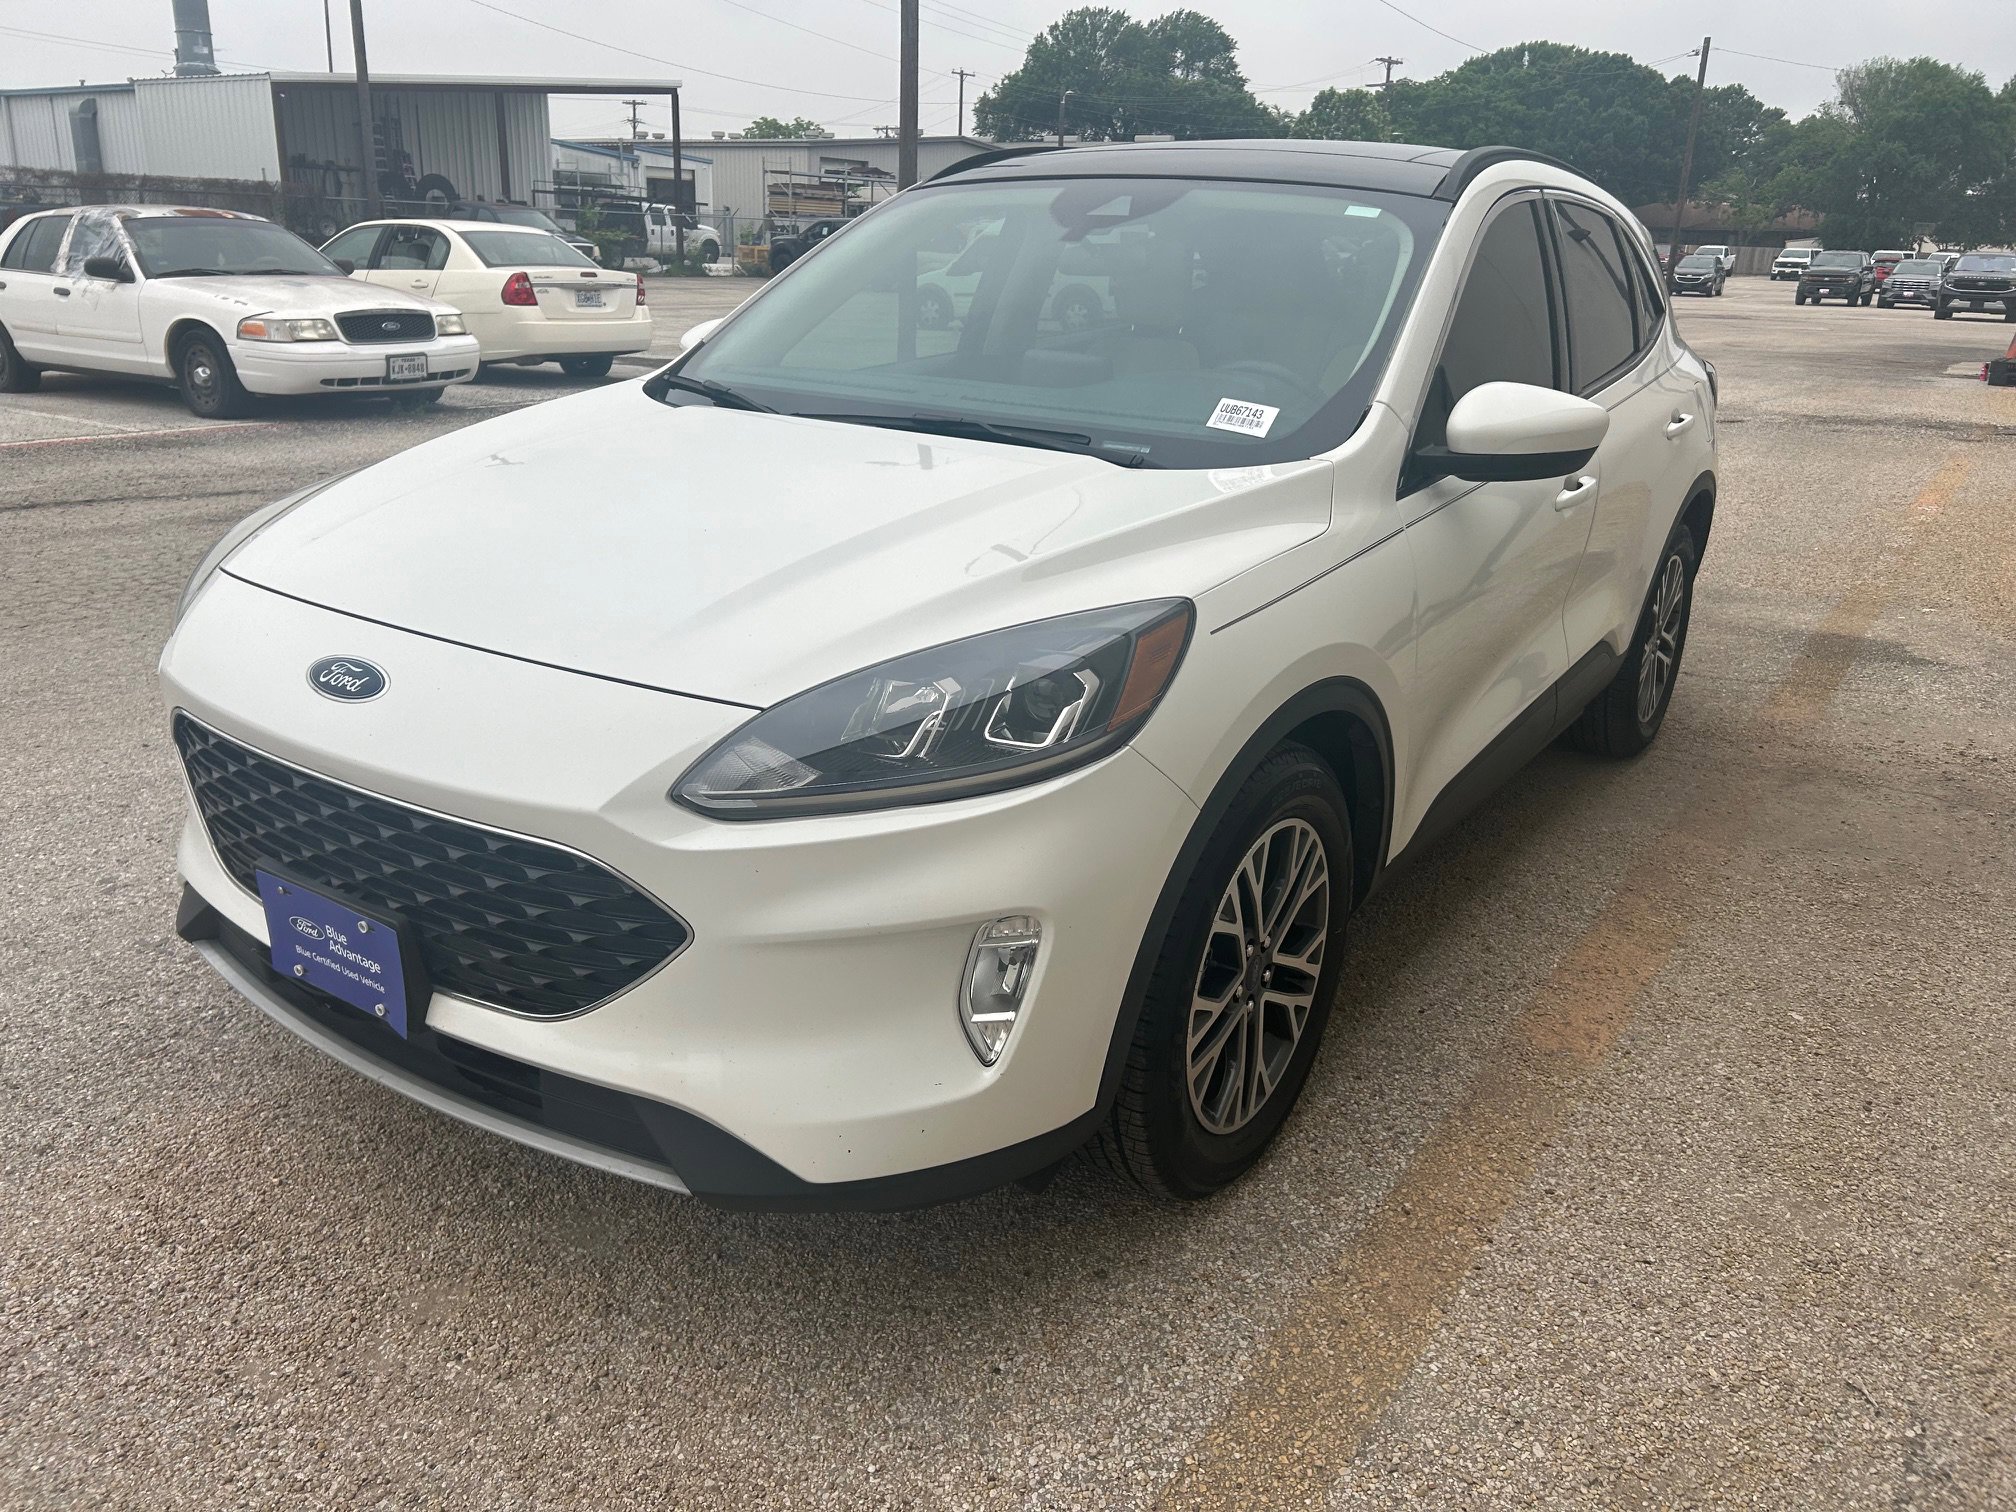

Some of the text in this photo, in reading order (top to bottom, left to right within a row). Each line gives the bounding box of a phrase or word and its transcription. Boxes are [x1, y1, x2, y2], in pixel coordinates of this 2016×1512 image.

[1220, 402, 1265, 419] UUB67143
[319, 661, 370, 692] Ford
[296, 918, 319, 938] Ford
[325, 924, 348, 945] Blue
[295, 944, 385, 994] Blue Certified Used Vehicle
[329, 940, 382, 974] Advantage
